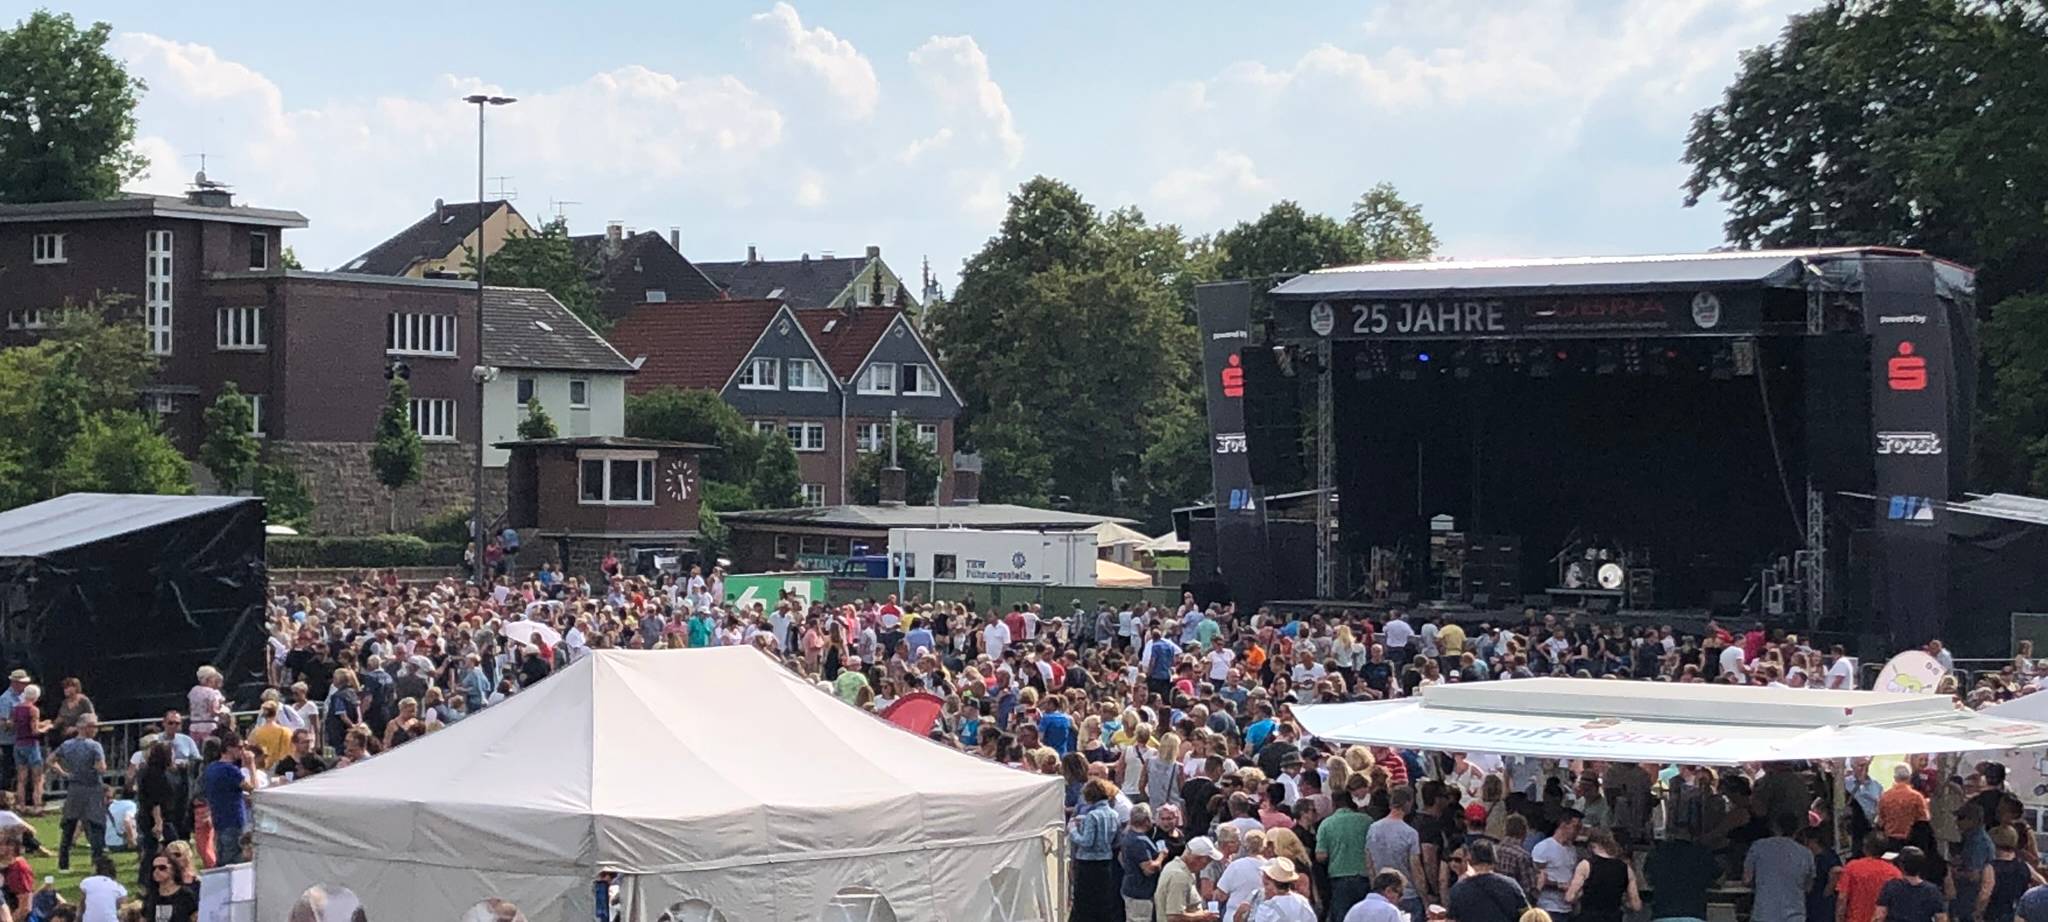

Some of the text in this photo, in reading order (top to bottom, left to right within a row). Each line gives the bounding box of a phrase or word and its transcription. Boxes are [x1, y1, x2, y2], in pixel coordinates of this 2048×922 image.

[1352, 304, 1388, 333] 25
[1396, 302, 1505, 333] JAHRE
[1880, 314, 1927, 324] powered by
[1575, 731, 1724, 746] KÖLSCH
